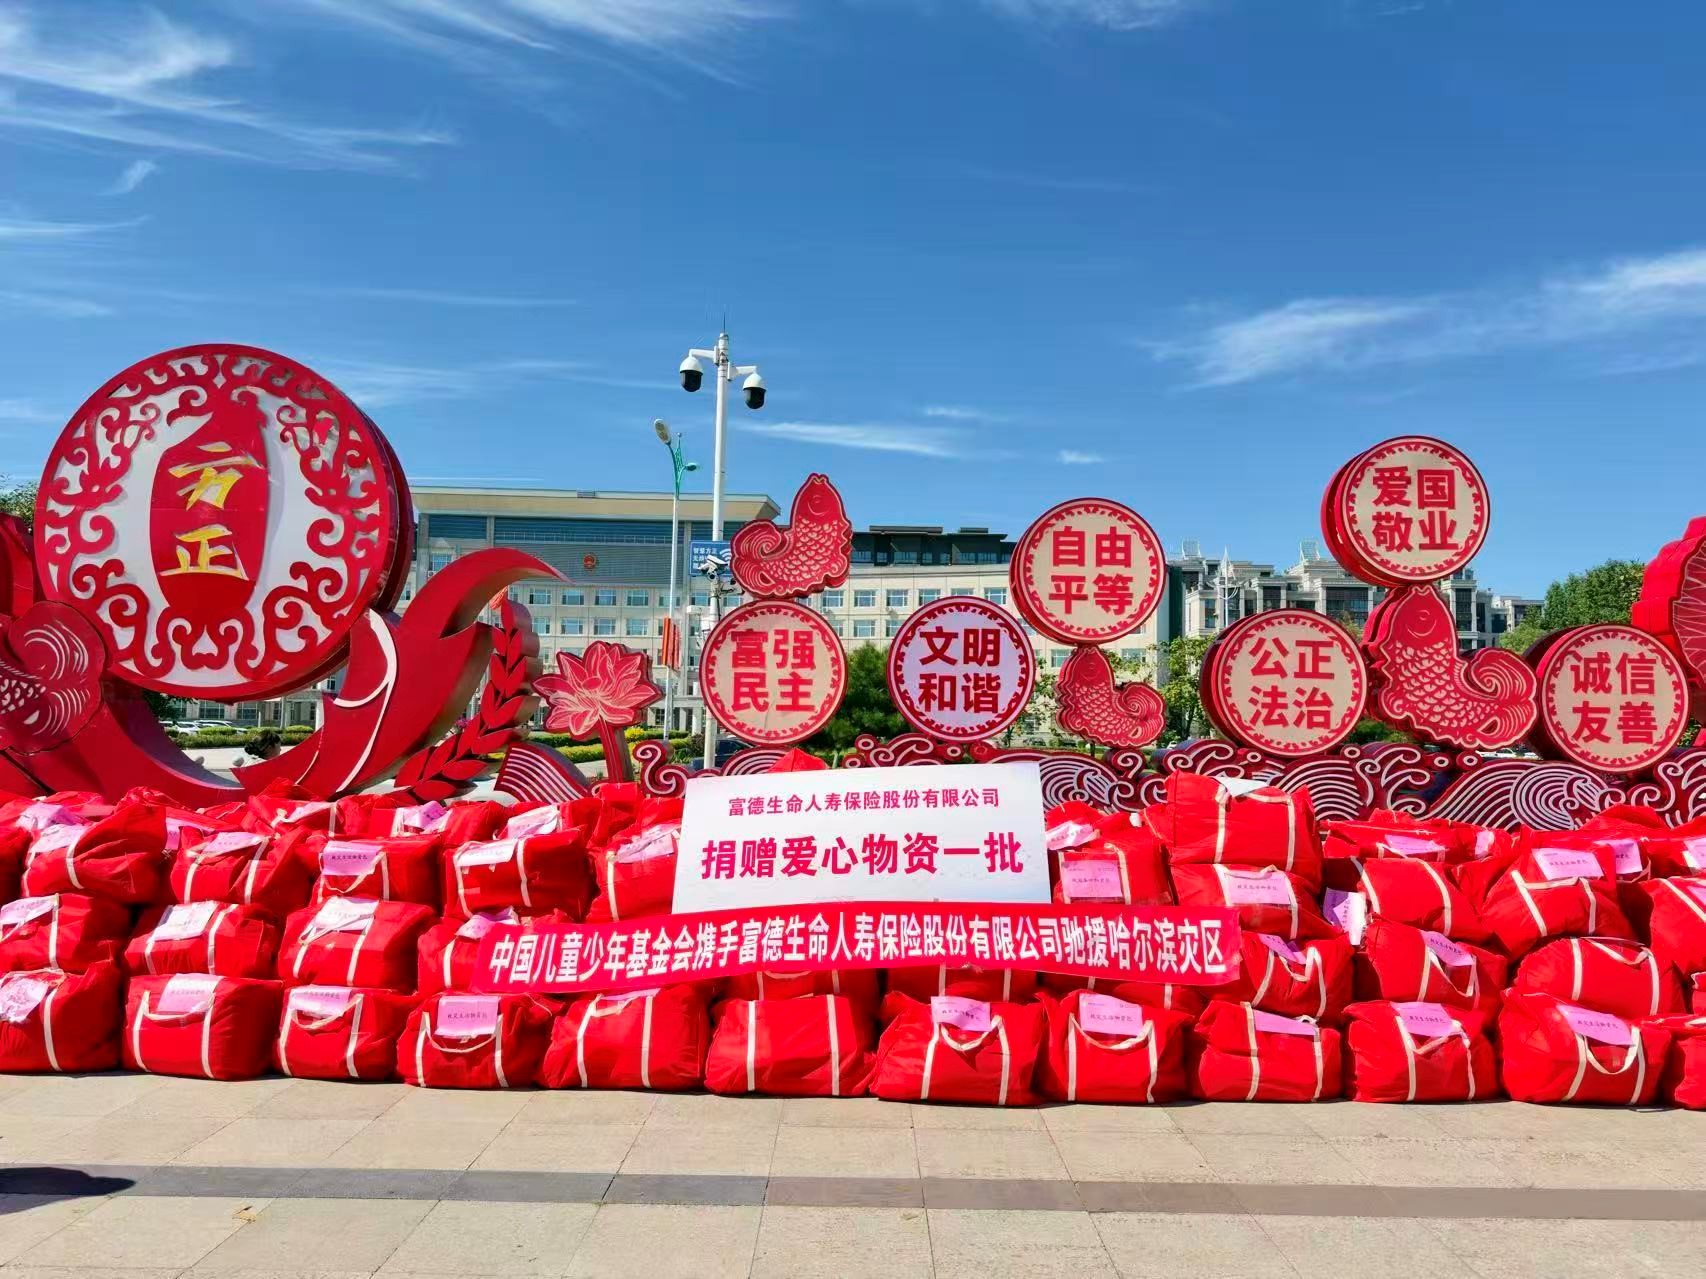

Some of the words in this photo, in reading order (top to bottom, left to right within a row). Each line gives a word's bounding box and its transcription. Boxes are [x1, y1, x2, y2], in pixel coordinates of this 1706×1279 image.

[1371, 465, 1456, 510] 爱国
[159, 441, 264, 581] 方正
[1371, 511, 1459, 554] 敬业
[1052, 525, 1133, 568] 自由
[1048, 573, 1134, 616] 平等
[731, 628, 816, 671] 富强
[919, 626, 1000, 667] 文明
[1248, 636, 1335, 681] 公正
[731, 671, 816, 713] 民主
[918, 673, 1001, 714] 和谐
[1570, 651, 1658, 697] 诚信
[1248, 685, 1334, 730] 法治
[1571, 701, 1658, 745] 友善
[728, 788, 1000, 817] 富德生命人寿保险股份有限公司
[701, 832, 1024, 880] 捐赠爱心物资一批
[488, 912, 1227, 984] 中国儿童少年基金会携手富德生命人寿保险股份有限公司驰援哈尔滨灾区
